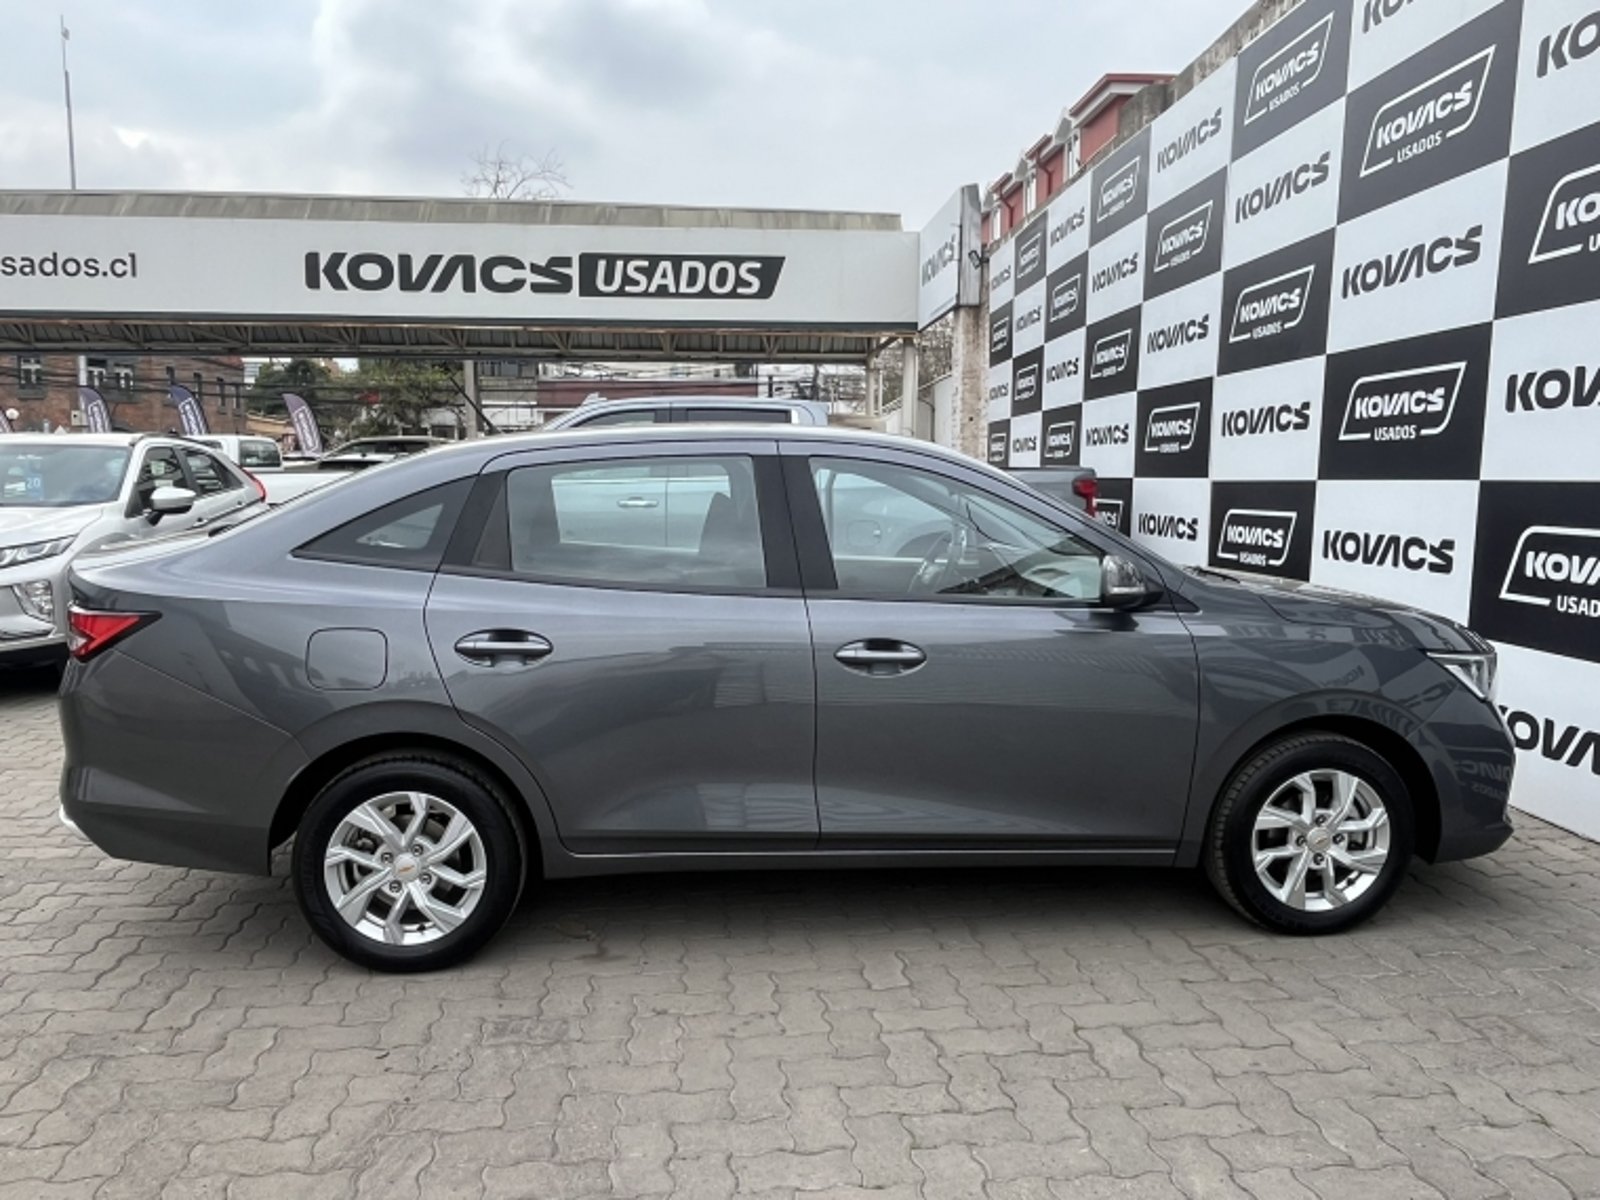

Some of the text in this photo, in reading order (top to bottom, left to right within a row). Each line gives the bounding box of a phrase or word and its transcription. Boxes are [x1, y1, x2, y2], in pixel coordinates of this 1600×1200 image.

[1255, 41, 1319, 101] KOVACS
[1377, 81, 1472, 149] KOVACS
[1157, 106, 1222, 173] KOVACS
[1396, 131, 1443, 163] USADOS
[1235, 150, 1331, 223] KOVACS
[0, 252, 137, 278] sados.cl
[304, 252, 763, 295] KOVACS USADOS
[1342, 224, 1483, 300] KOVACS
[1240, 287, 1301, 323] KOVACS
[1147, 313, 1209, 354] KOVACS
[1354, 387, 1446, 420] KOVACS
[1505, 365, 1600, 413] KOV
[1150, 418, 1193, 438] KOVACS
[1221, 401, 1311, 438] KOVACS
[1374, 424, 1417, 441] USADOS
[1138, 513, 1199, 541] KOVACS
[1225, 524, 1284, 549] KOVACS
[1322, 530, 1455, 575] KOVACS
[1498, 704, 1600, 776] OVA
